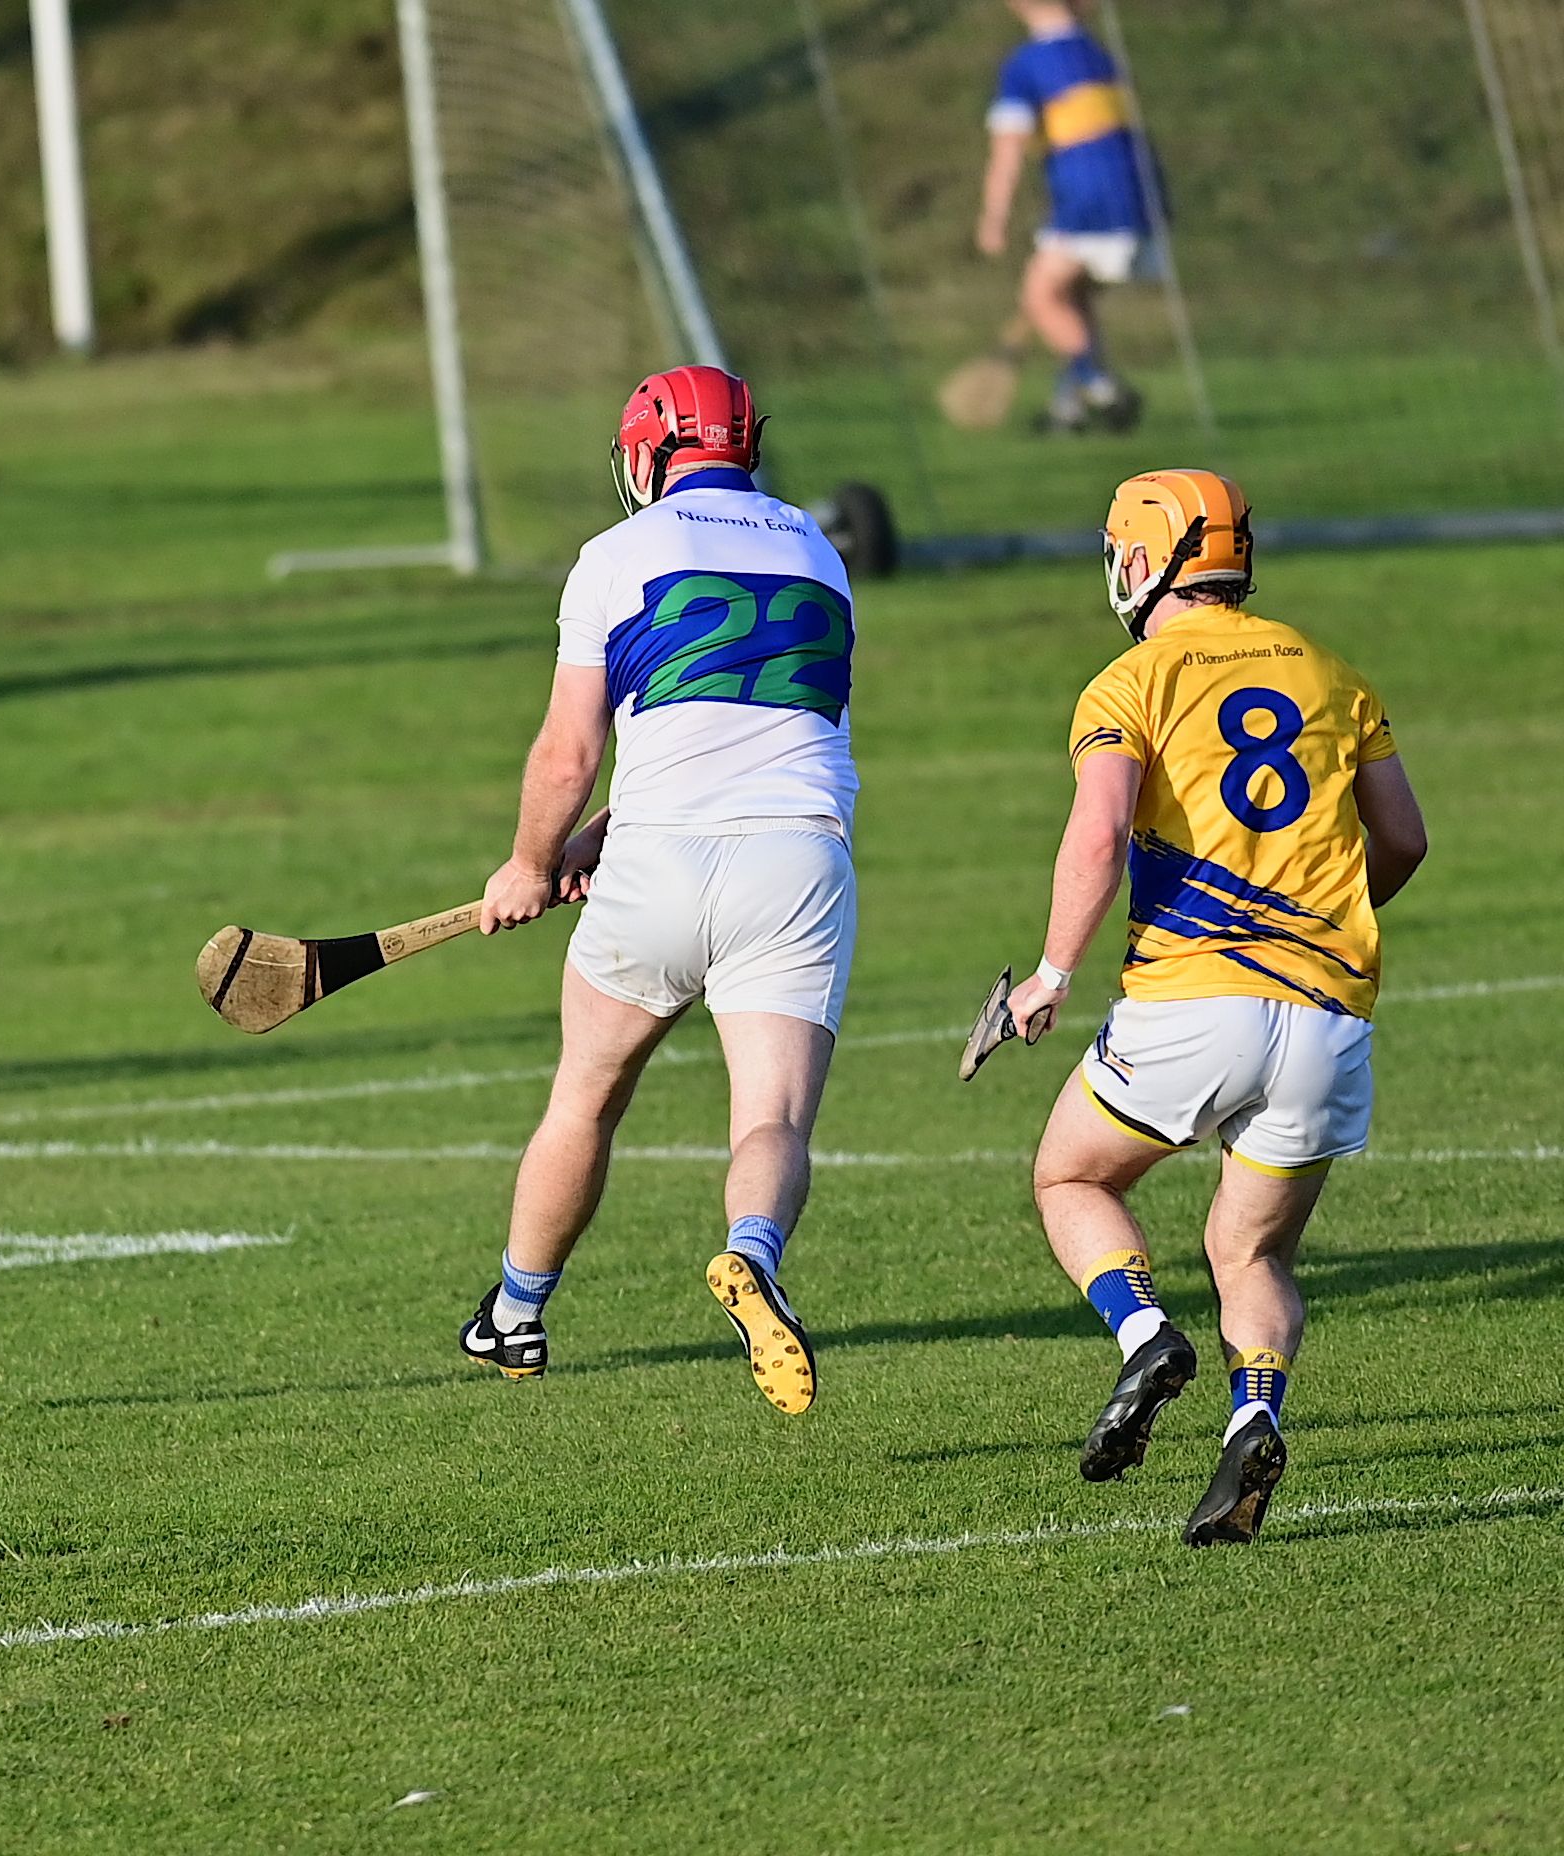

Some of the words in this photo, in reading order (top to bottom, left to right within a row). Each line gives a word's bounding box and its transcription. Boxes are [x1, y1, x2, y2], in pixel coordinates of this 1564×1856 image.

[676, 510, 758, 528] Naomh
[764, 518, 808, 536] Eoin
[642, 575, 847, 728] 22
[1273, 643, 1304, 657] Rosa
[1217, 687, 1311, 833] 8
